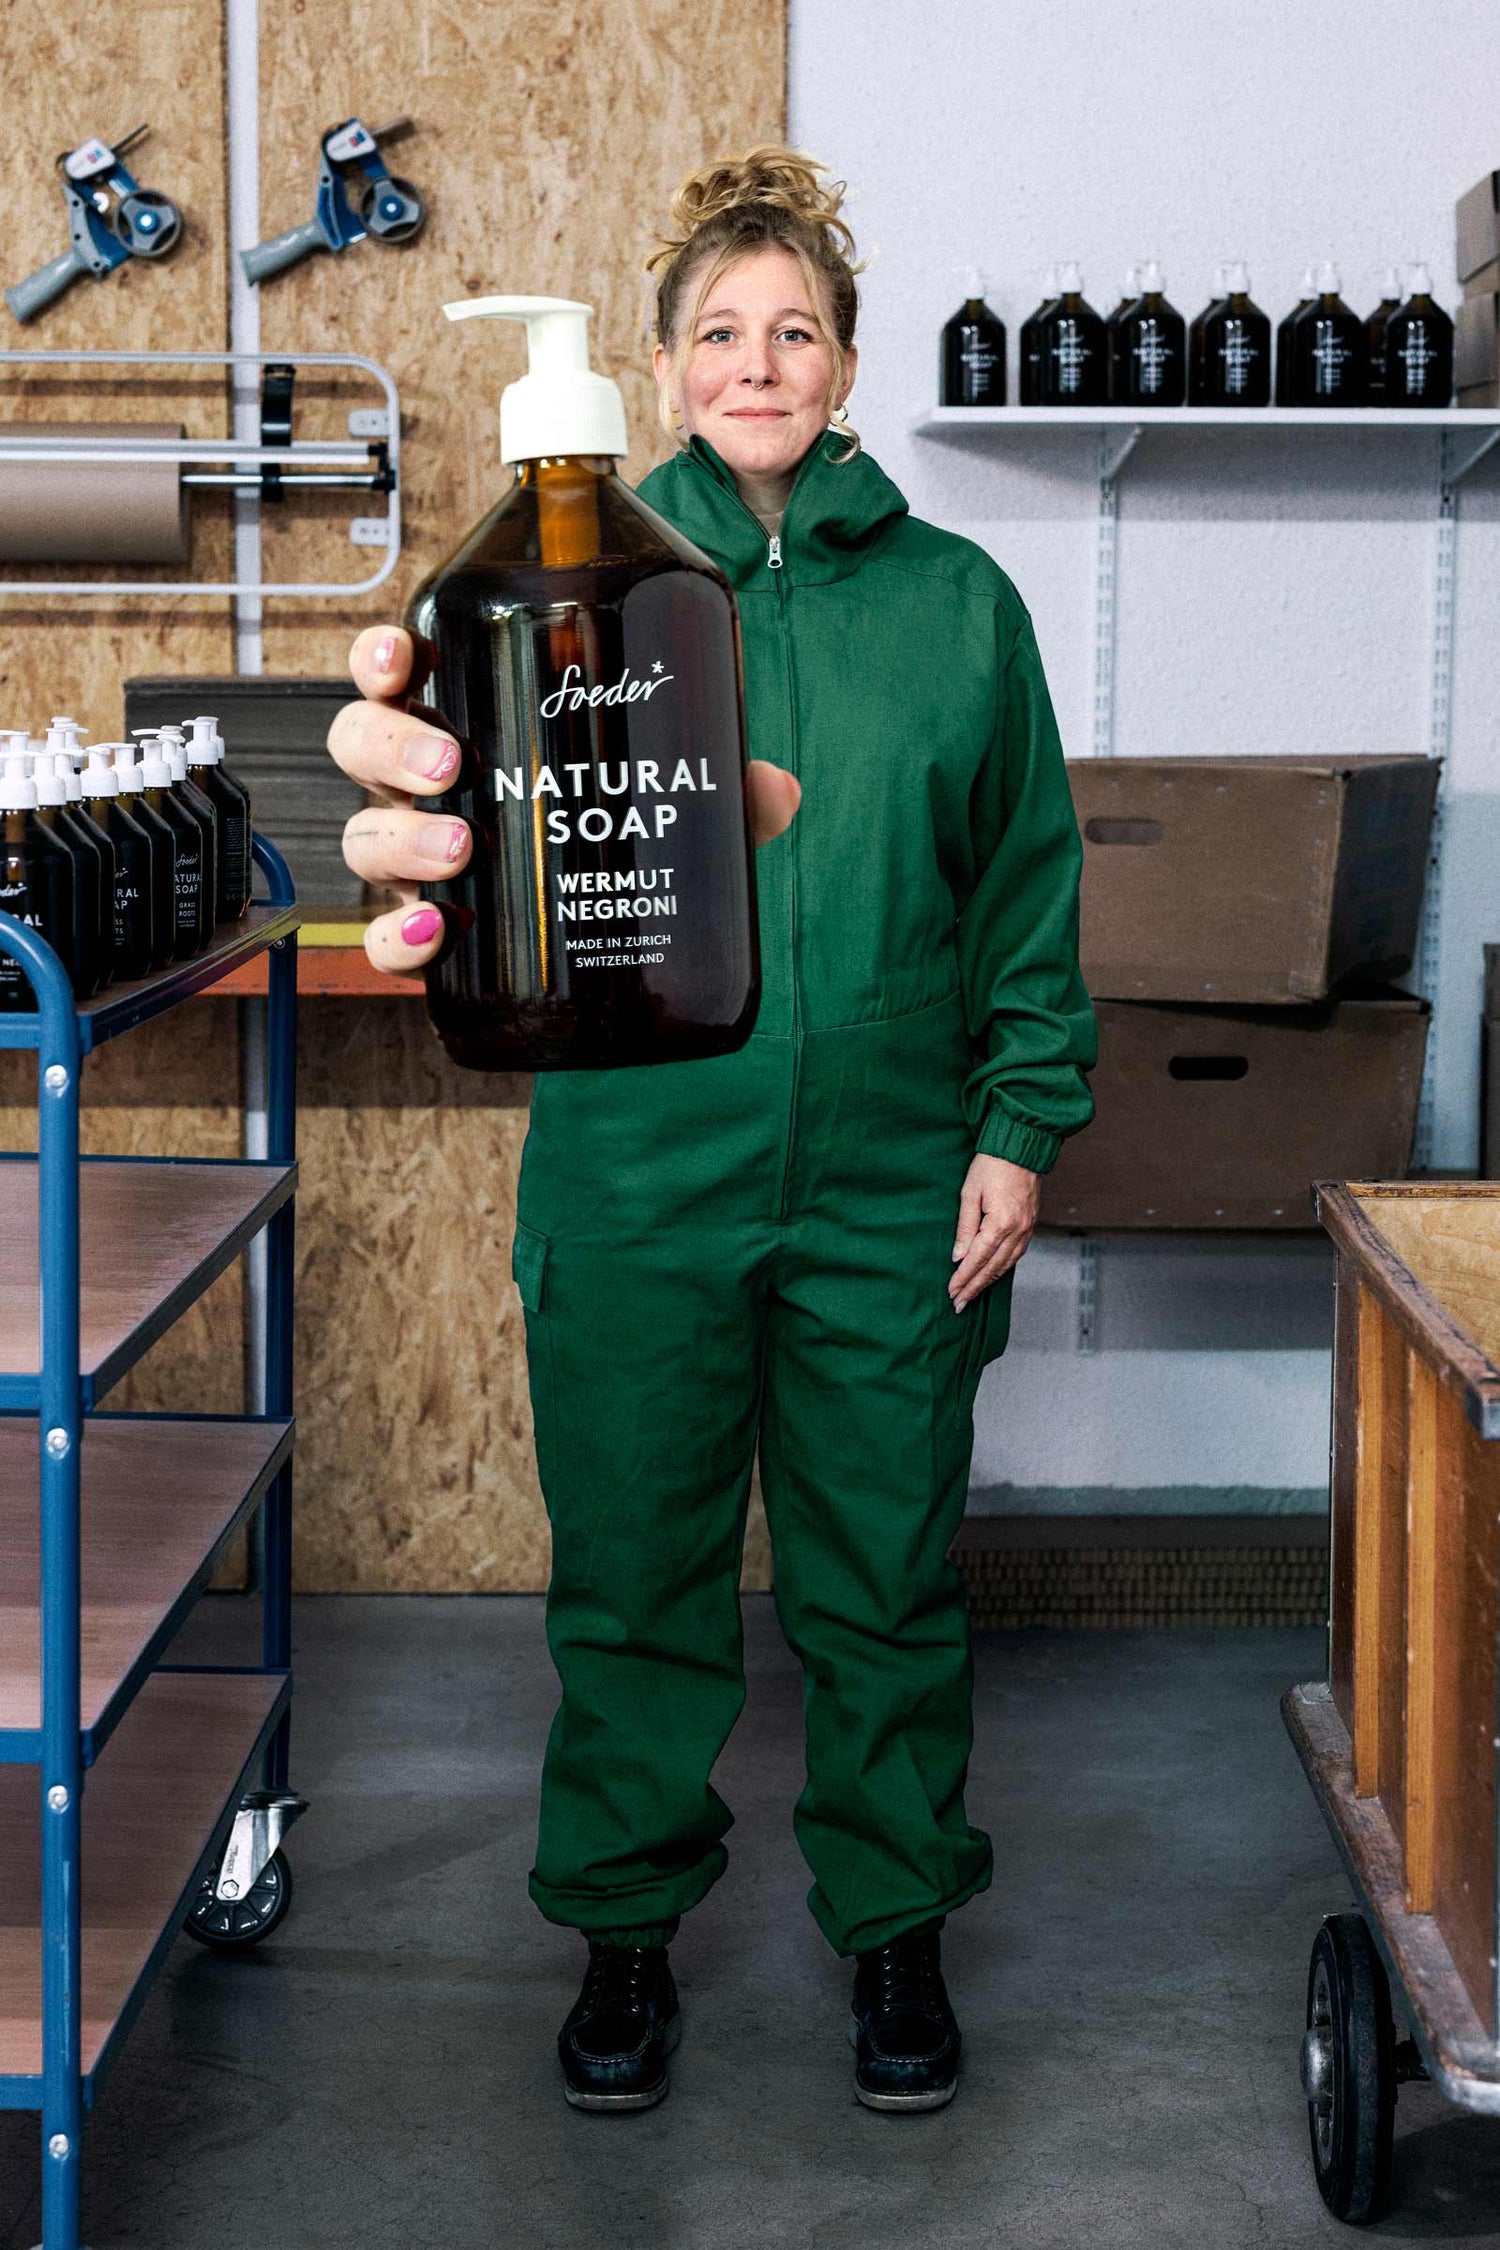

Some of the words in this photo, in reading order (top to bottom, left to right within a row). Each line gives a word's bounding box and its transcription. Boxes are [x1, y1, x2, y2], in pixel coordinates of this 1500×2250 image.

[494, 757, 718, 802] NATURAL
[546, 804, 679, 845] SOAP
[556, 868, 675, 894] WERMUT
[557, 895, 678, 922] NEGRONI
[566, 938, 604, 951] MADE
[606, 937, 622, 948] IN
[624, 934, 672, 948] ZURICH
[575, 952, 665, 968] SWITZERLAND
